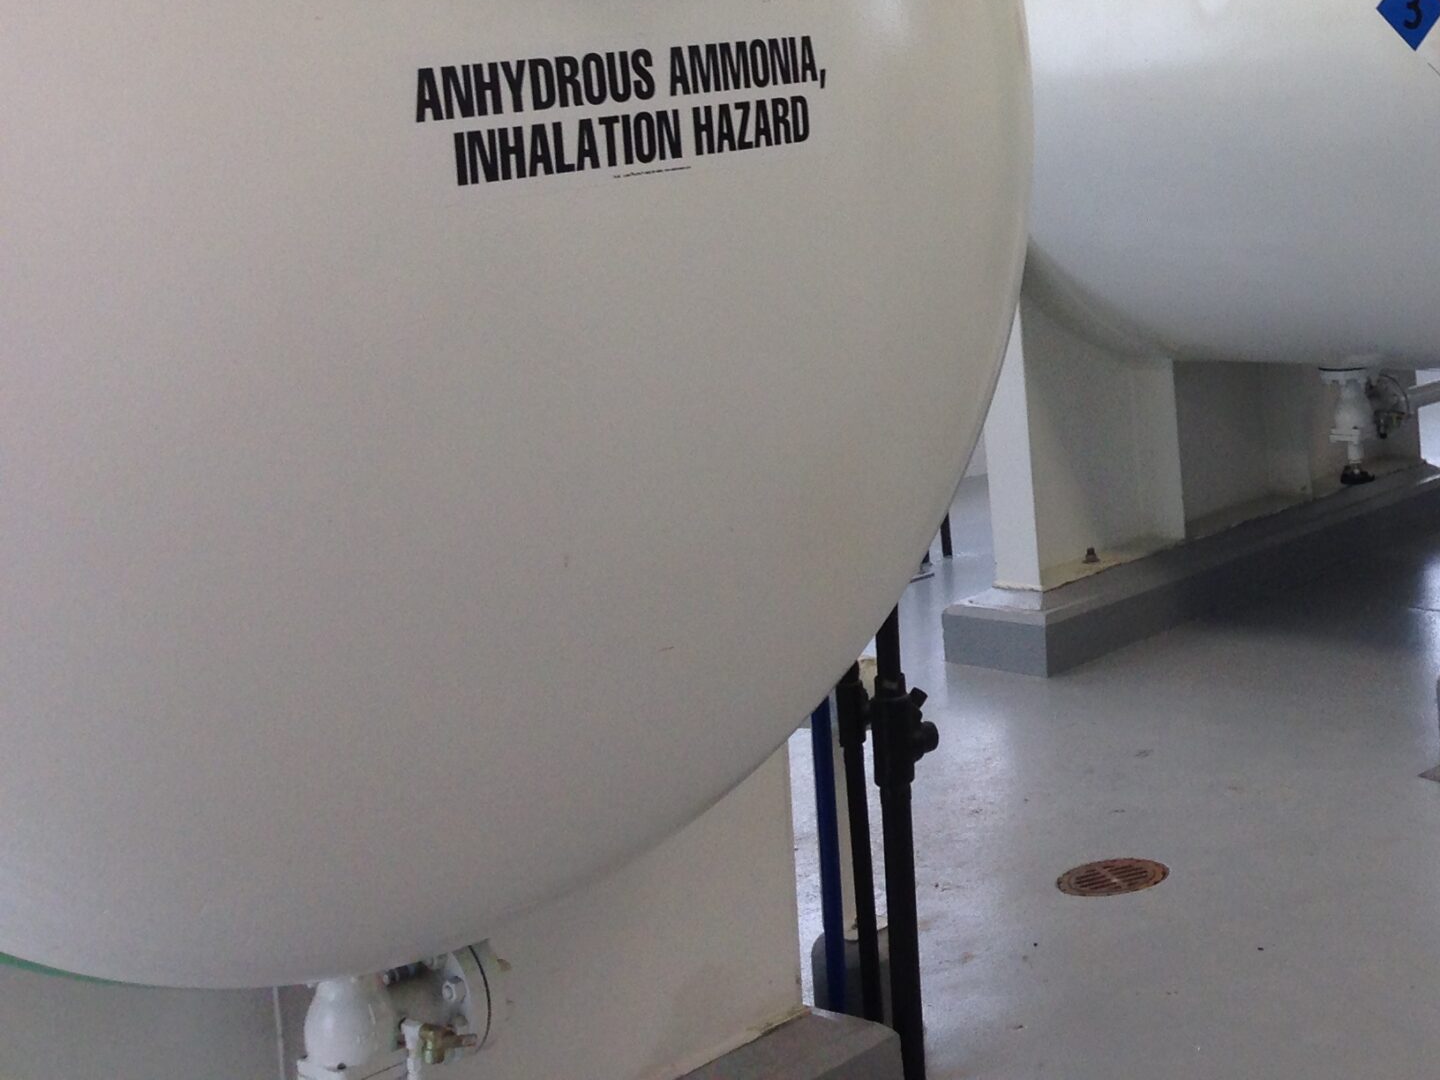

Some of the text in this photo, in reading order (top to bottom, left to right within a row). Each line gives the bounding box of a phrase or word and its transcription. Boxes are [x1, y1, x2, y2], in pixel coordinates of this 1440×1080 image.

[415, 34, 827, 123] ANHYDROUS AMMONIA,
[453, 95, 811, 186] INHALATION HAZARD
